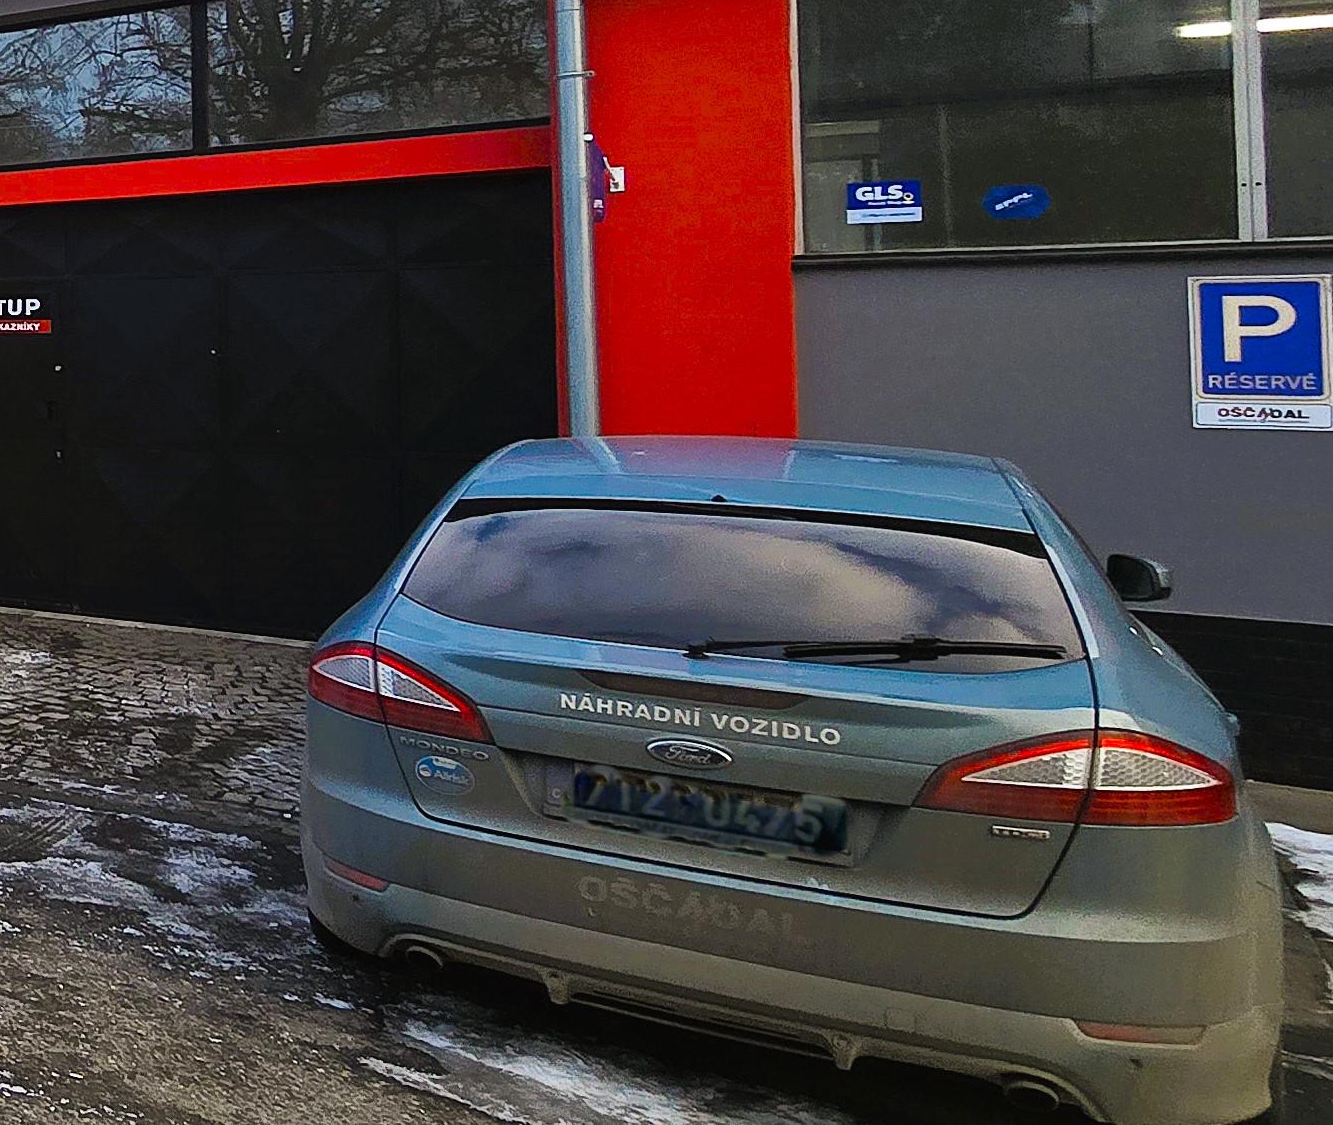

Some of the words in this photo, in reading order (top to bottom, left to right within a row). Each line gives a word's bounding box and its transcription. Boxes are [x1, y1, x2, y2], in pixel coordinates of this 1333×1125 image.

[855, 185, 903, 201] GLS
[1222, 295, 1297, 362] P
[1208, 372, 1317, 390] RÉSERVÉ
[560, 692, 700, 727] NÁHRADNÍ
[710, 713, 841, 745] VOZIDLO
[400, 736, 489, 760] MONDEO
[664, 745, 710, 765] Ford
